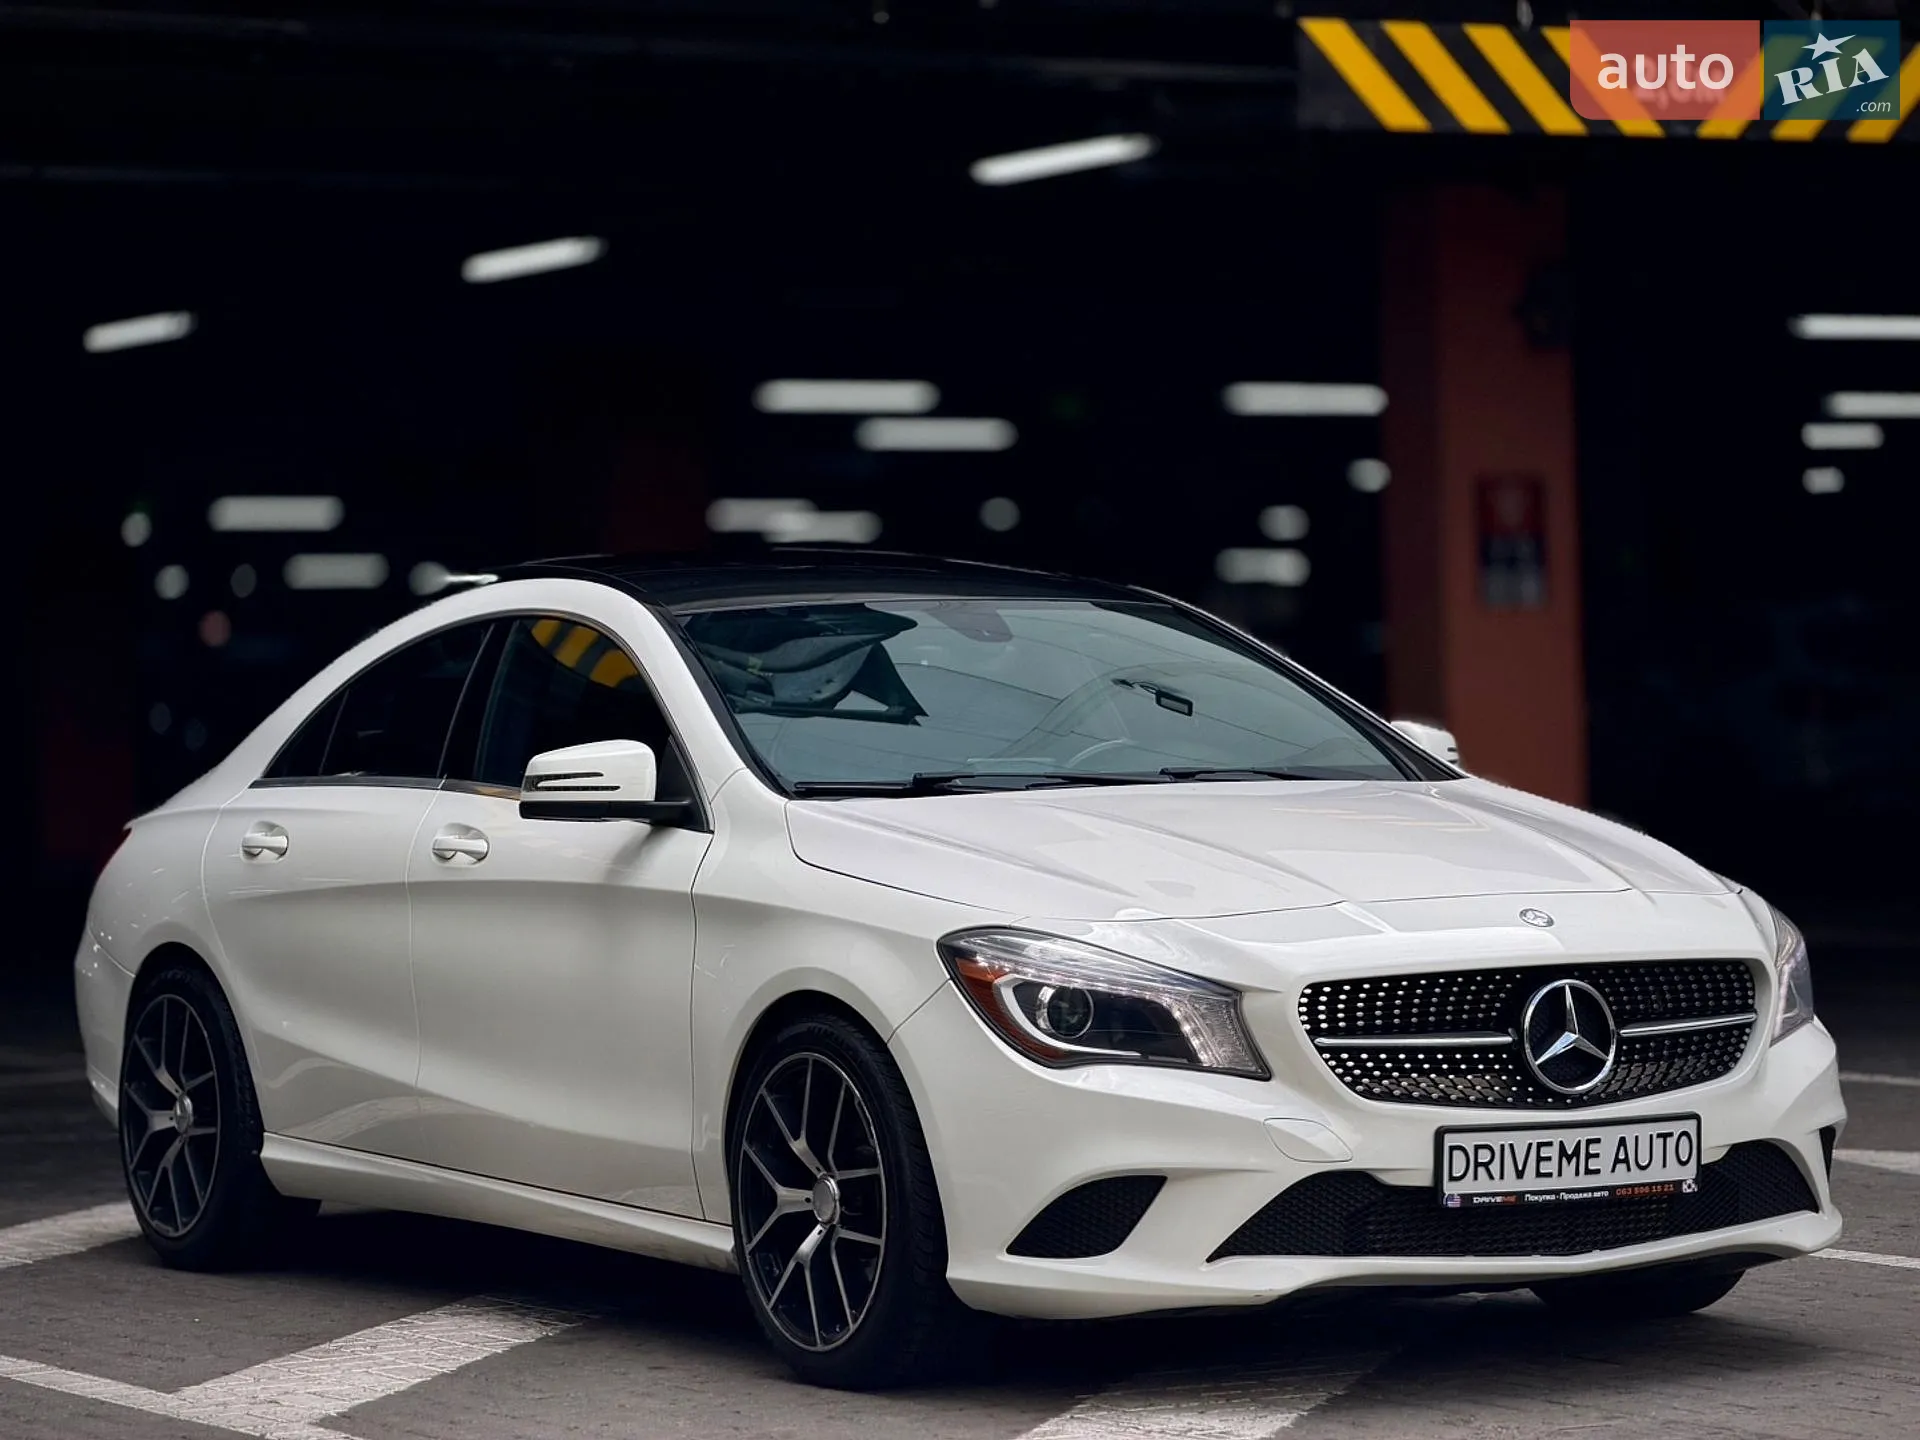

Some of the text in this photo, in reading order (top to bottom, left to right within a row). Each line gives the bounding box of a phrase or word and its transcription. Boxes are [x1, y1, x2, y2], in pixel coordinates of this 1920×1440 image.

[1447, 1130, 1694, 1182] DRIVEME AUTO
[1525, 1194, 1556, 1202] Покупка
[1560, 1191, 1592, 1200] Продажа
[1593, 1190, 1609, 1198] авто
